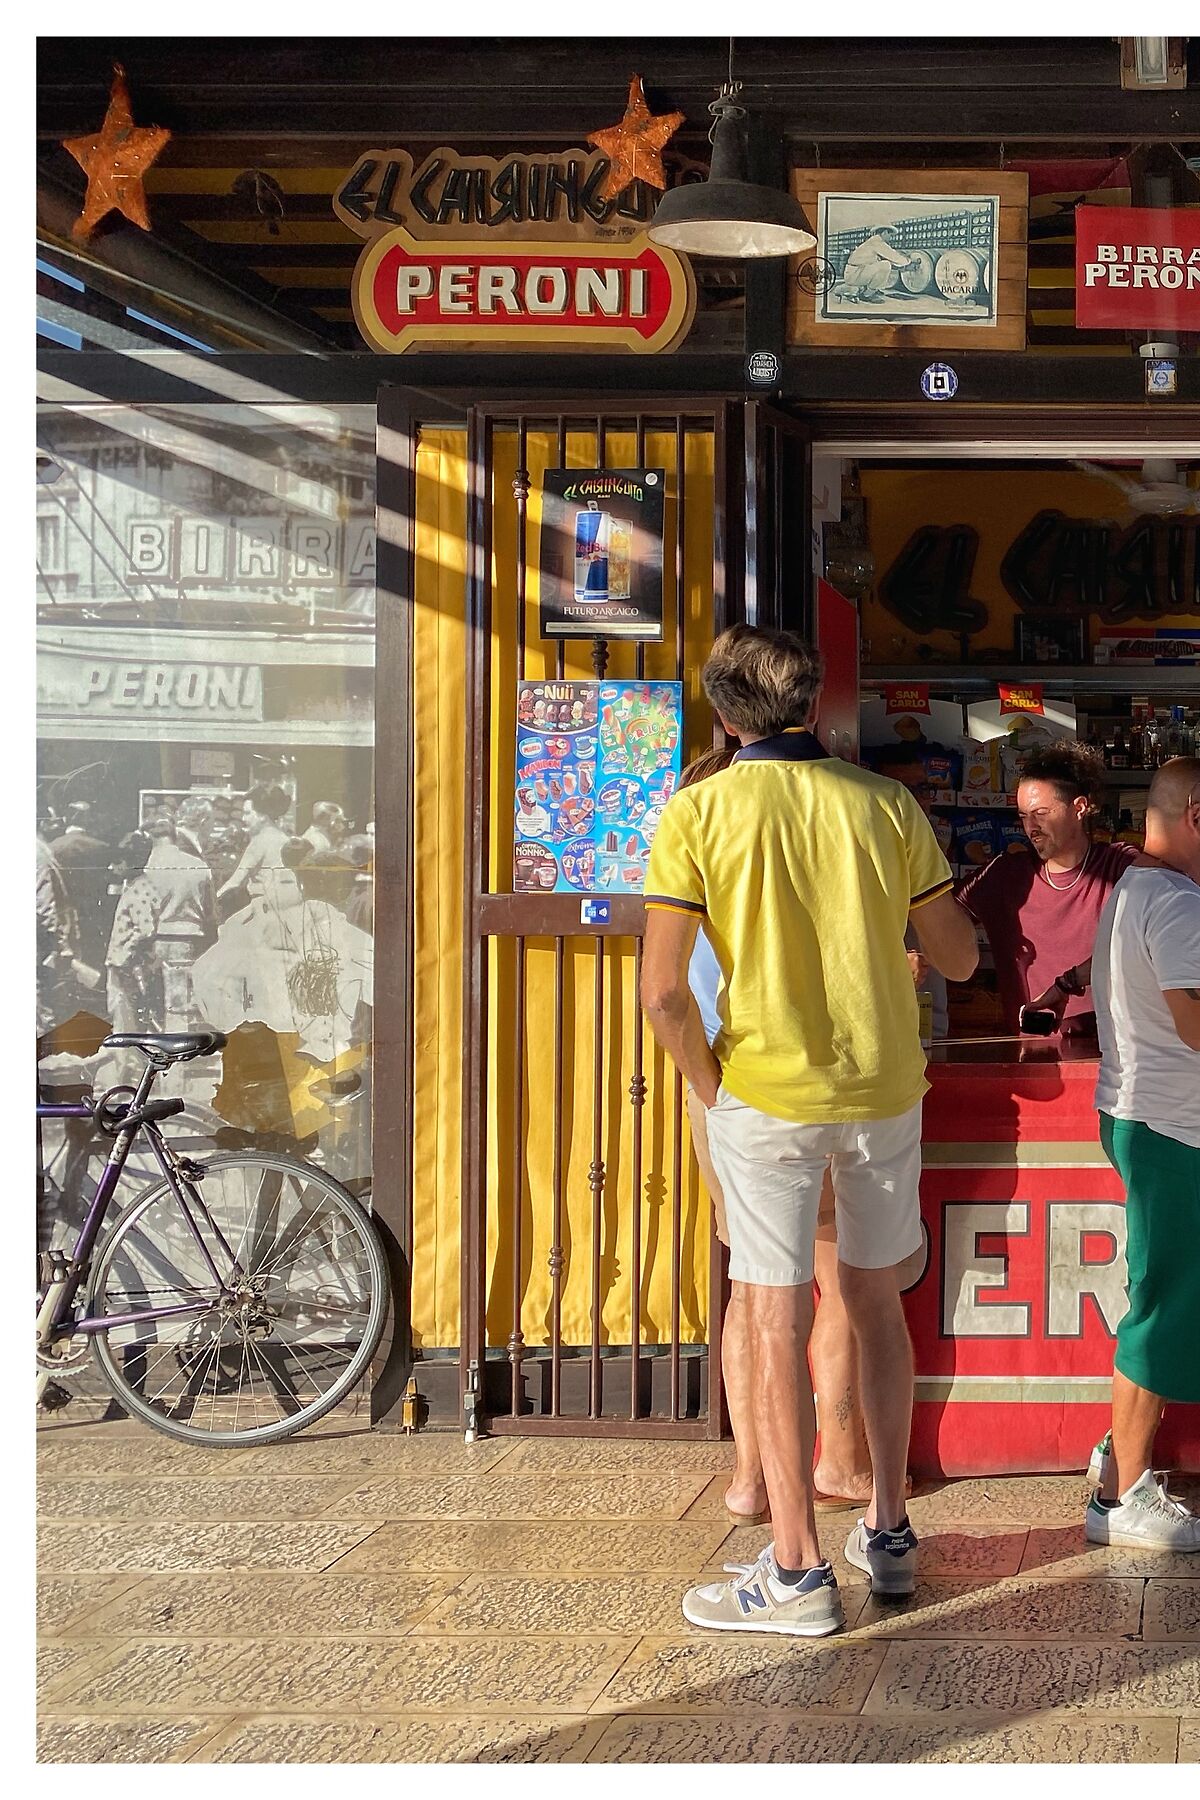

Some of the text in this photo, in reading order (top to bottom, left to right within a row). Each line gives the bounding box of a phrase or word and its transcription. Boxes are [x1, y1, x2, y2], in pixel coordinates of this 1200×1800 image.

[338, 159, 407, 225] EL
[395, 265, 649, 318] PERONI
[77, 664, 263, 709] PERONI
[895, 690, 919, 699] SAN
[1009, 690, 1033, 699] SAN
[889, 699, 926, 708] CARLO
[1003, 699, 1040, 708] CARLO
[515, 846, 546, 857] NONNO
